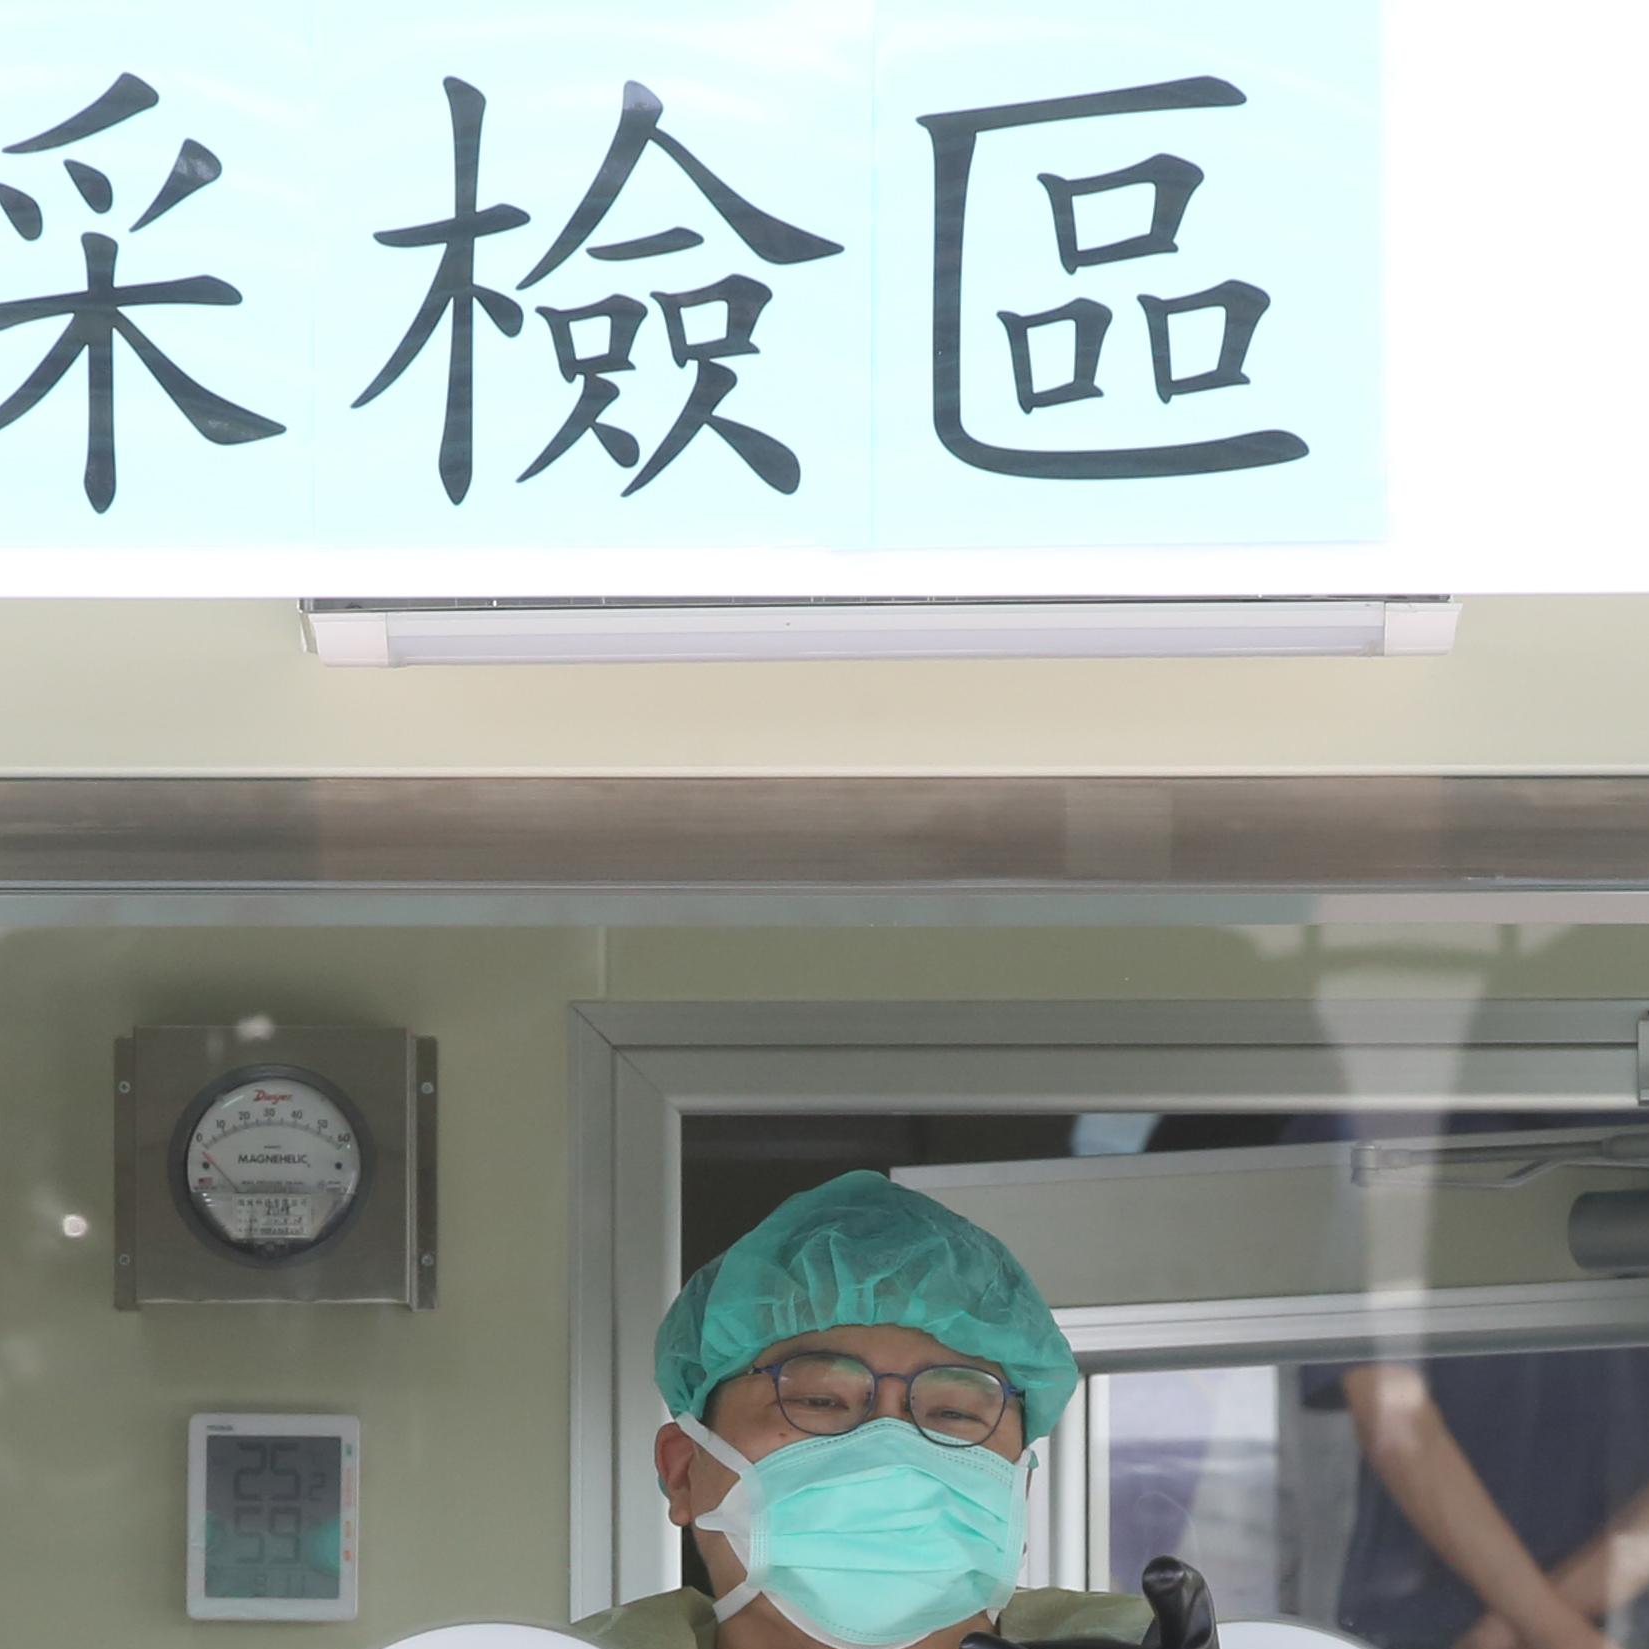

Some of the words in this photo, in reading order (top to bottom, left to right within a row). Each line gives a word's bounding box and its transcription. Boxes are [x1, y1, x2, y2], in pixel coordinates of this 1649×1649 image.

[253, 1089, 293, 1105] Dwyer
[196, 1133, 203, 1142] 0
[216, 1120, 226, 1128] 10
[239, 1111, 251, 1120] 20
[263, 1108, 276, 1117] 30
[291, 1110, 303, 1119] 40
[317, 1120, 328, 1128] 50
[338, 1133, 350, 1142] 60
[238, 1154, 307, 1164] MAGNEHELIC
